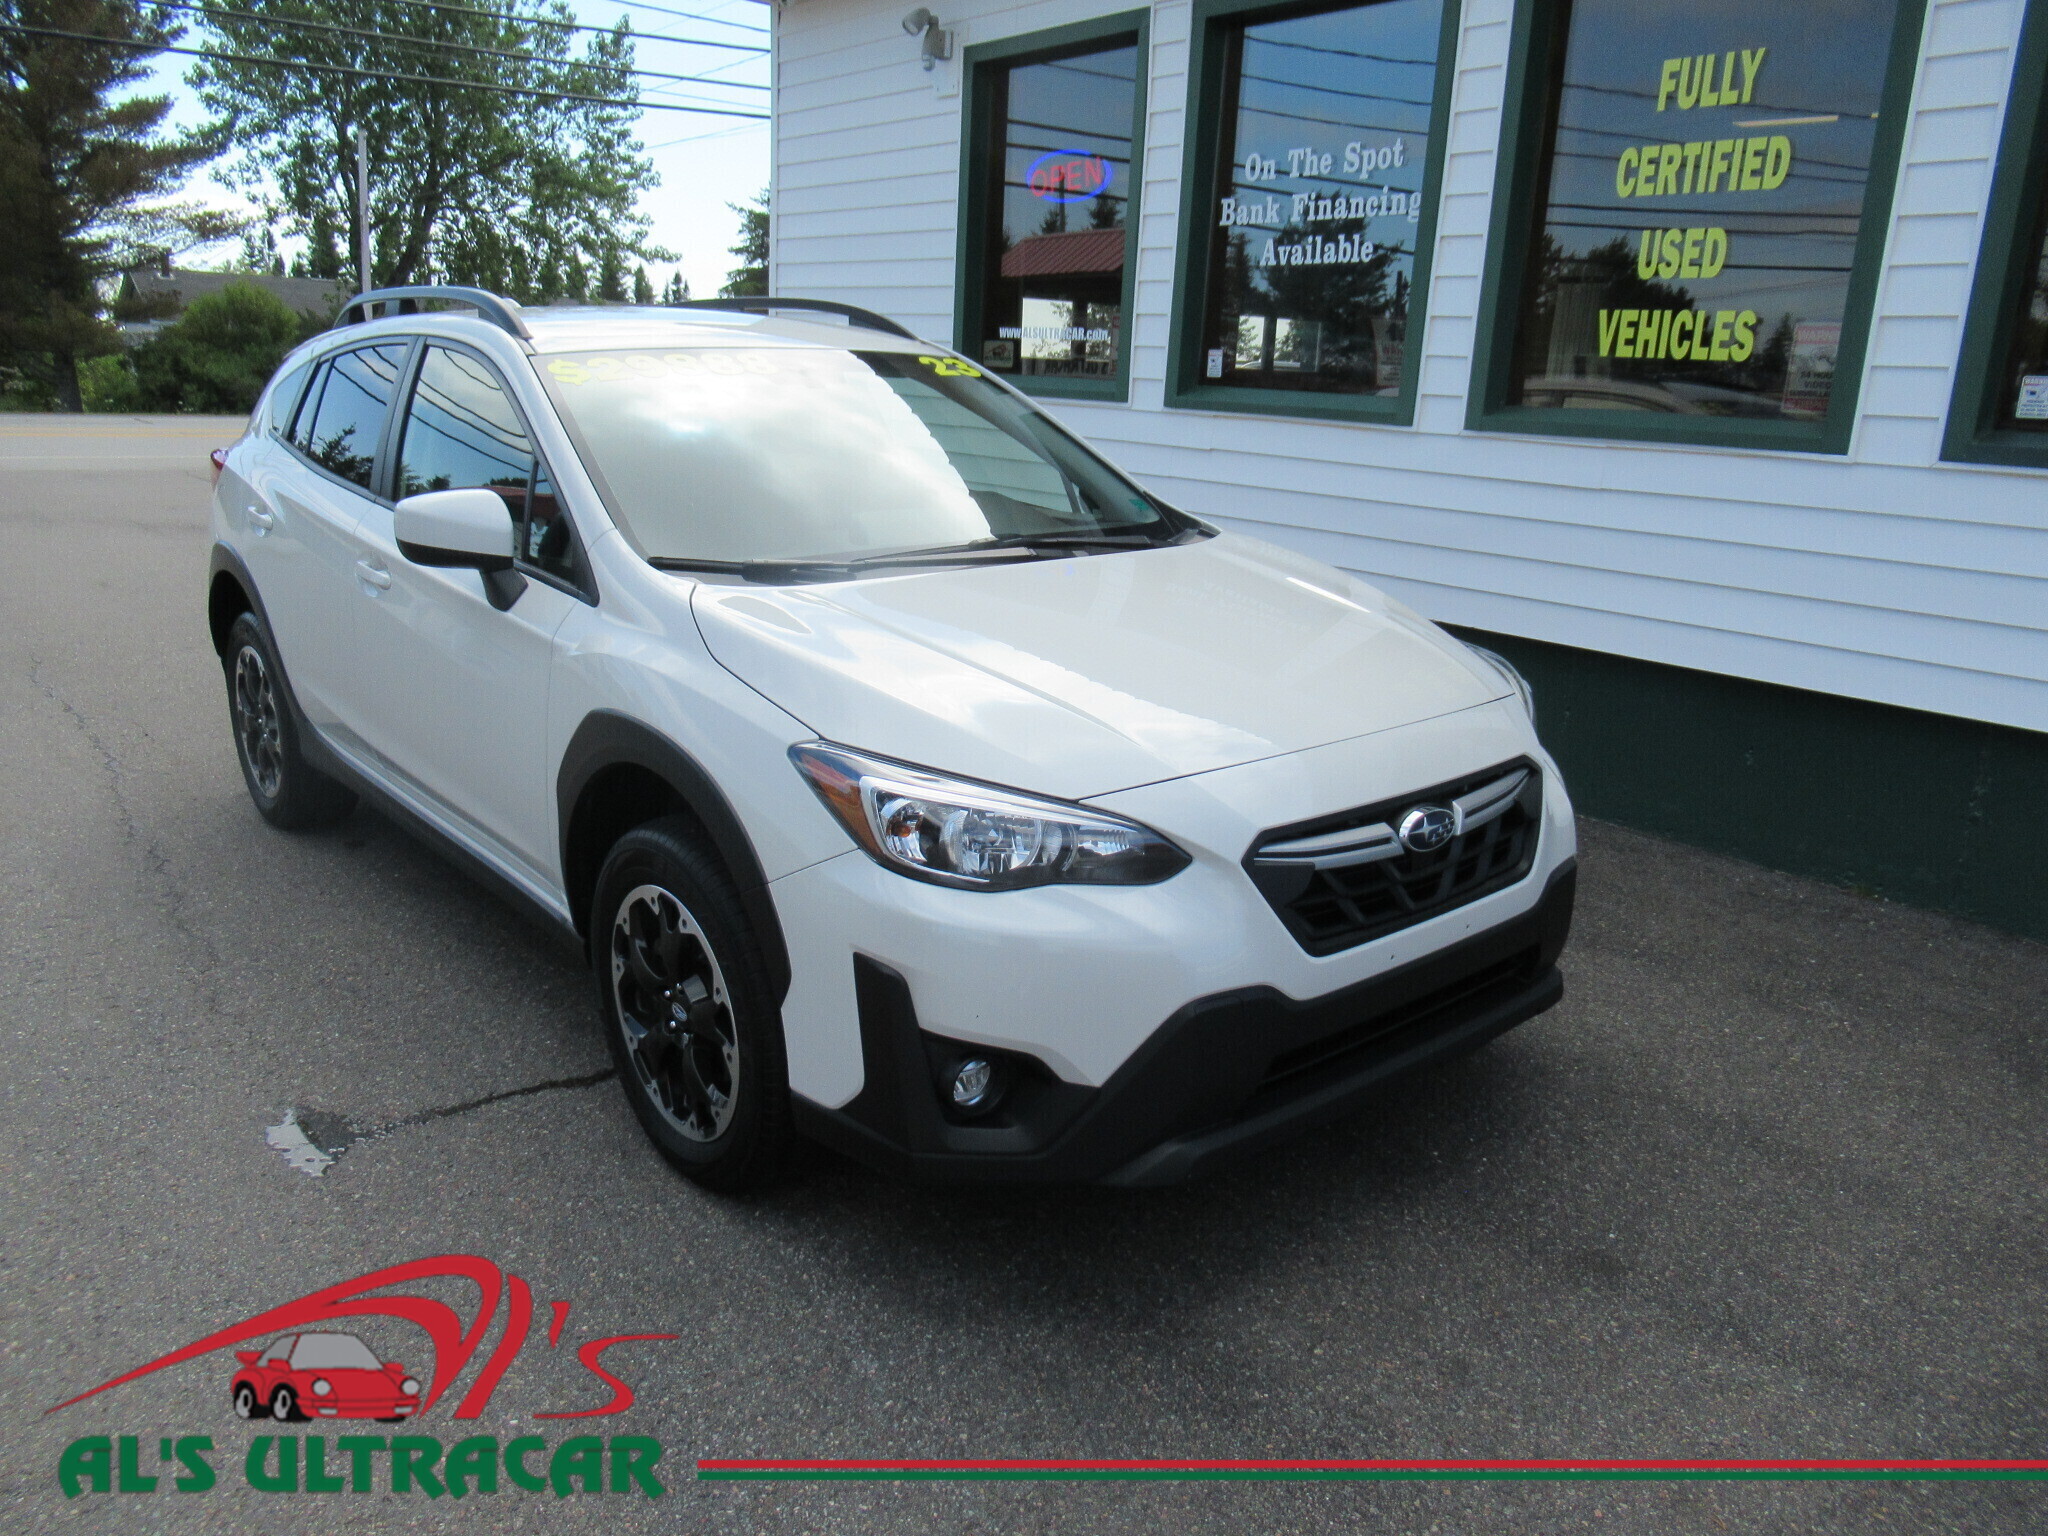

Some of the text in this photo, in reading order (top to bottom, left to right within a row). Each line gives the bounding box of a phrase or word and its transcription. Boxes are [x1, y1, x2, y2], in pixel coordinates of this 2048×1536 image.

[1658, 48, 1765, 111] FULLY
[1030, 156, 1103, 198] OPEN
[1245, 137, 1405, 182] On The Spot
[1617, 135, 1791, 198] CERTIFIED
[1219, 185, 1422, 227] Bank Financing
[1258, 233, 1374, 267] Available
[1636, 227, 1728, 282] USED
[1598, 308, 1758, 363] VEHICLES
[917, 355, 983, 378] 23
